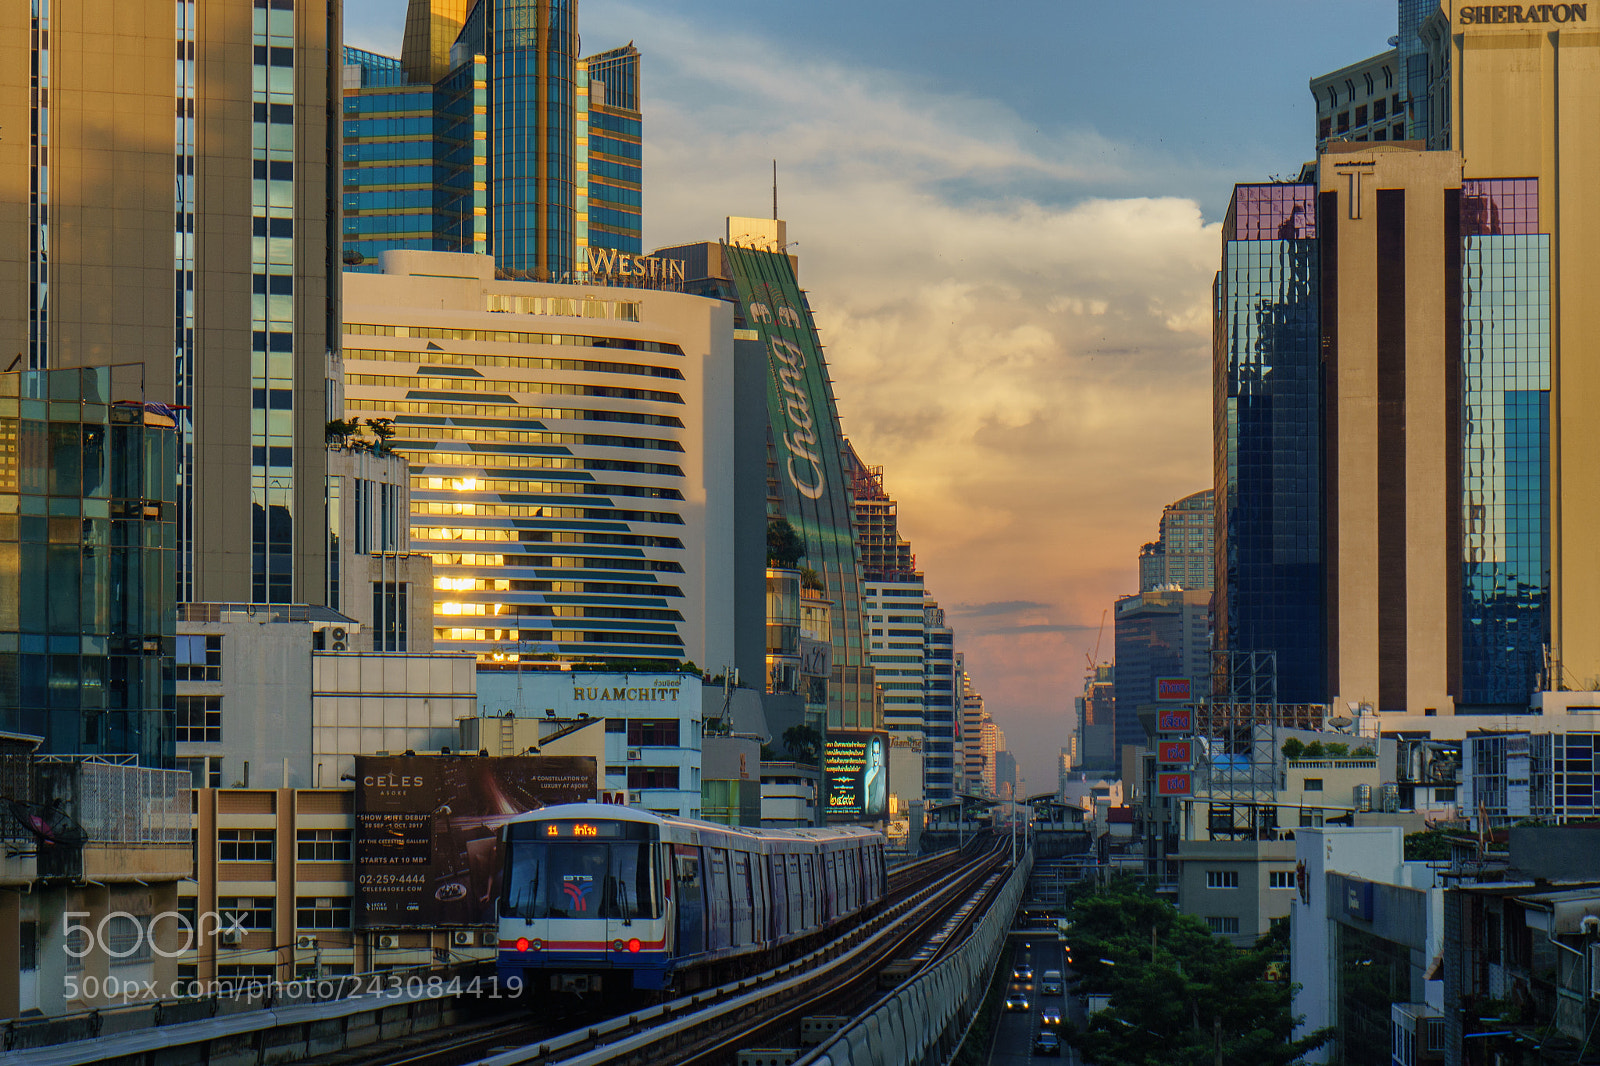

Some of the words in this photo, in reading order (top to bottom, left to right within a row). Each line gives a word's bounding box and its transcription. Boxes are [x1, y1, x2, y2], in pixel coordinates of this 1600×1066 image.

[1459, 3, 1588, 25] SHERATON
[585, 247, 686, 281] WESTIN
[770, 334, 825, 500] Chang
[573, 687, 680, 701] RUAMCHITT
[363, 775, 424, 788] CELES
[547, 824, 559, 836] 11
